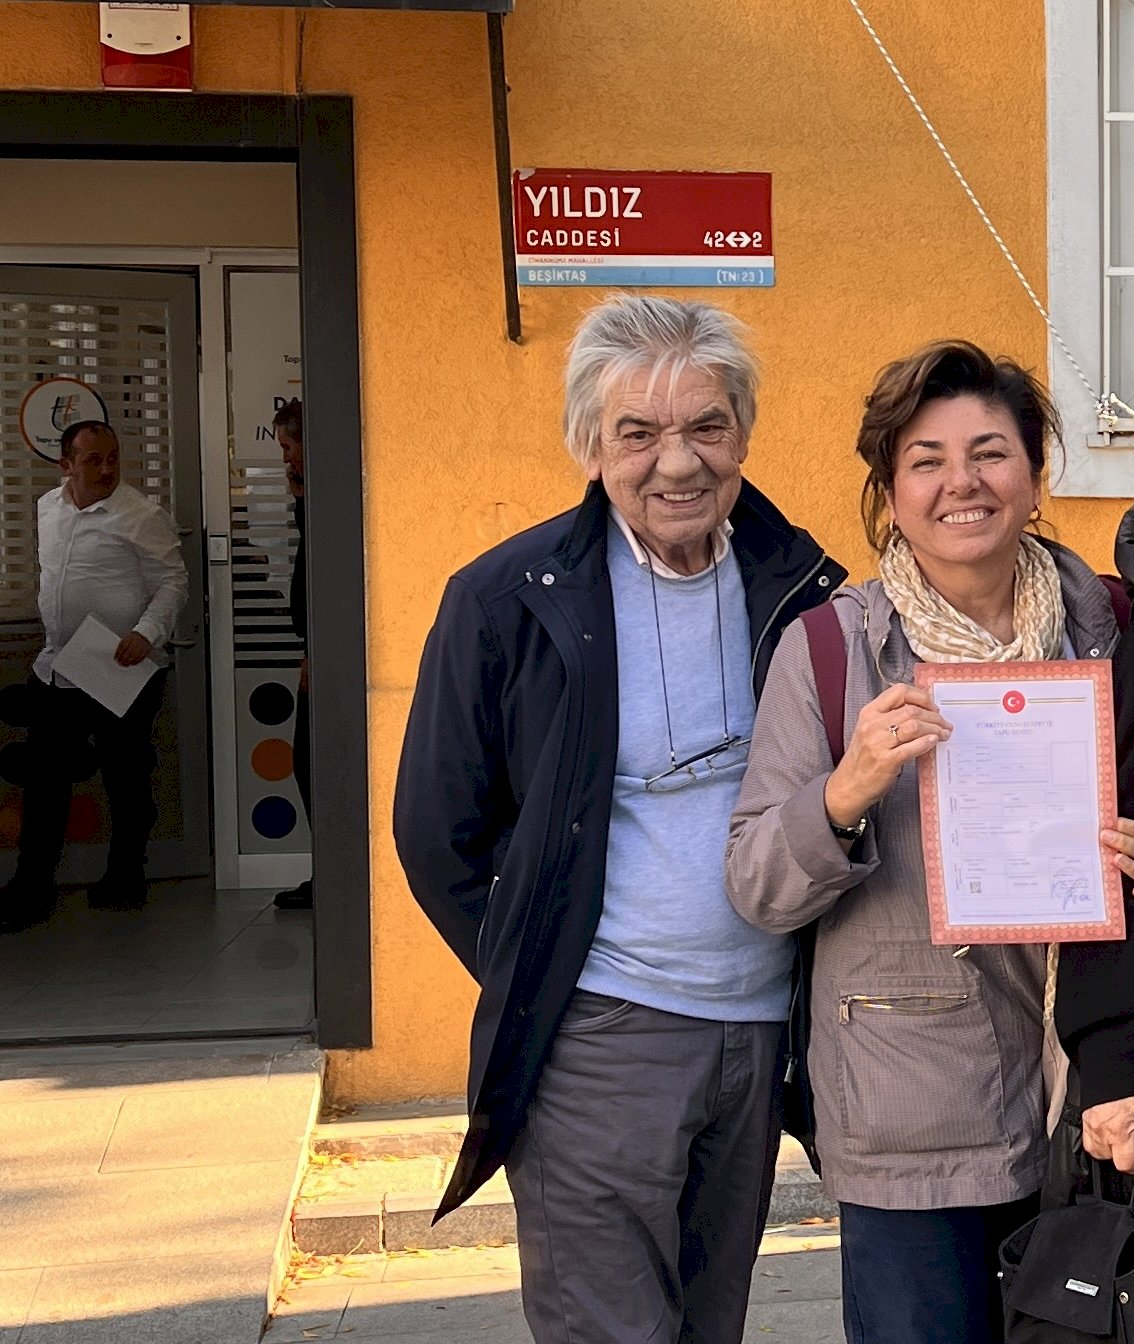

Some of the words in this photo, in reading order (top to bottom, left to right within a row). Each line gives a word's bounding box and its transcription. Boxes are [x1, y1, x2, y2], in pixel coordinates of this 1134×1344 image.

[524, 186, 643, 218] YILDIZ
[526, 227, 621, 247] CADDESİ
[703, 230, 725, 248] 42
[752, 231, 763, 248] 2
[528, 269, 587, 282] BEŞİKTAŞ
